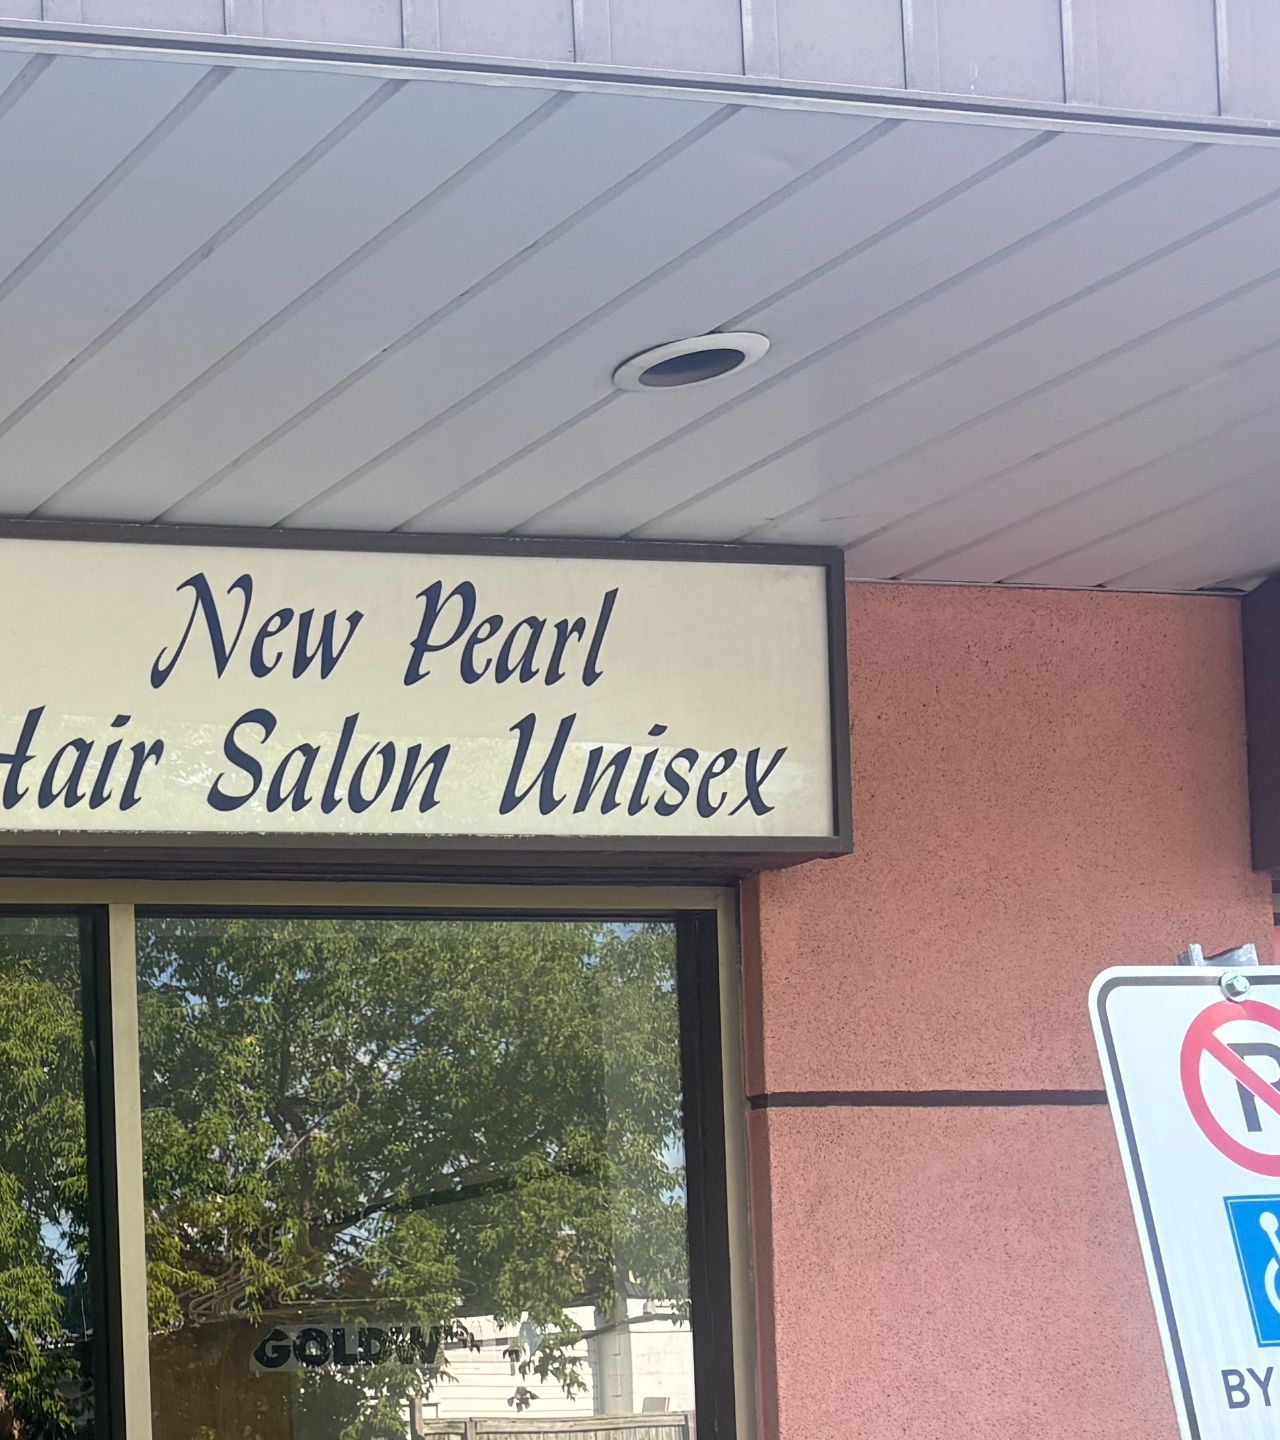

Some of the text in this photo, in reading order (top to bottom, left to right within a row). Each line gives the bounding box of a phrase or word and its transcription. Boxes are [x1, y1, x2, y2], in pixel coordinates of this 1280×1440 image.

[150, 572, 619, 688] New Pearl
[207, 708, 451, 814] Salon
[498, 712, 788, 819] Unisex
[1221, 1366, 1274, 1409] BY
